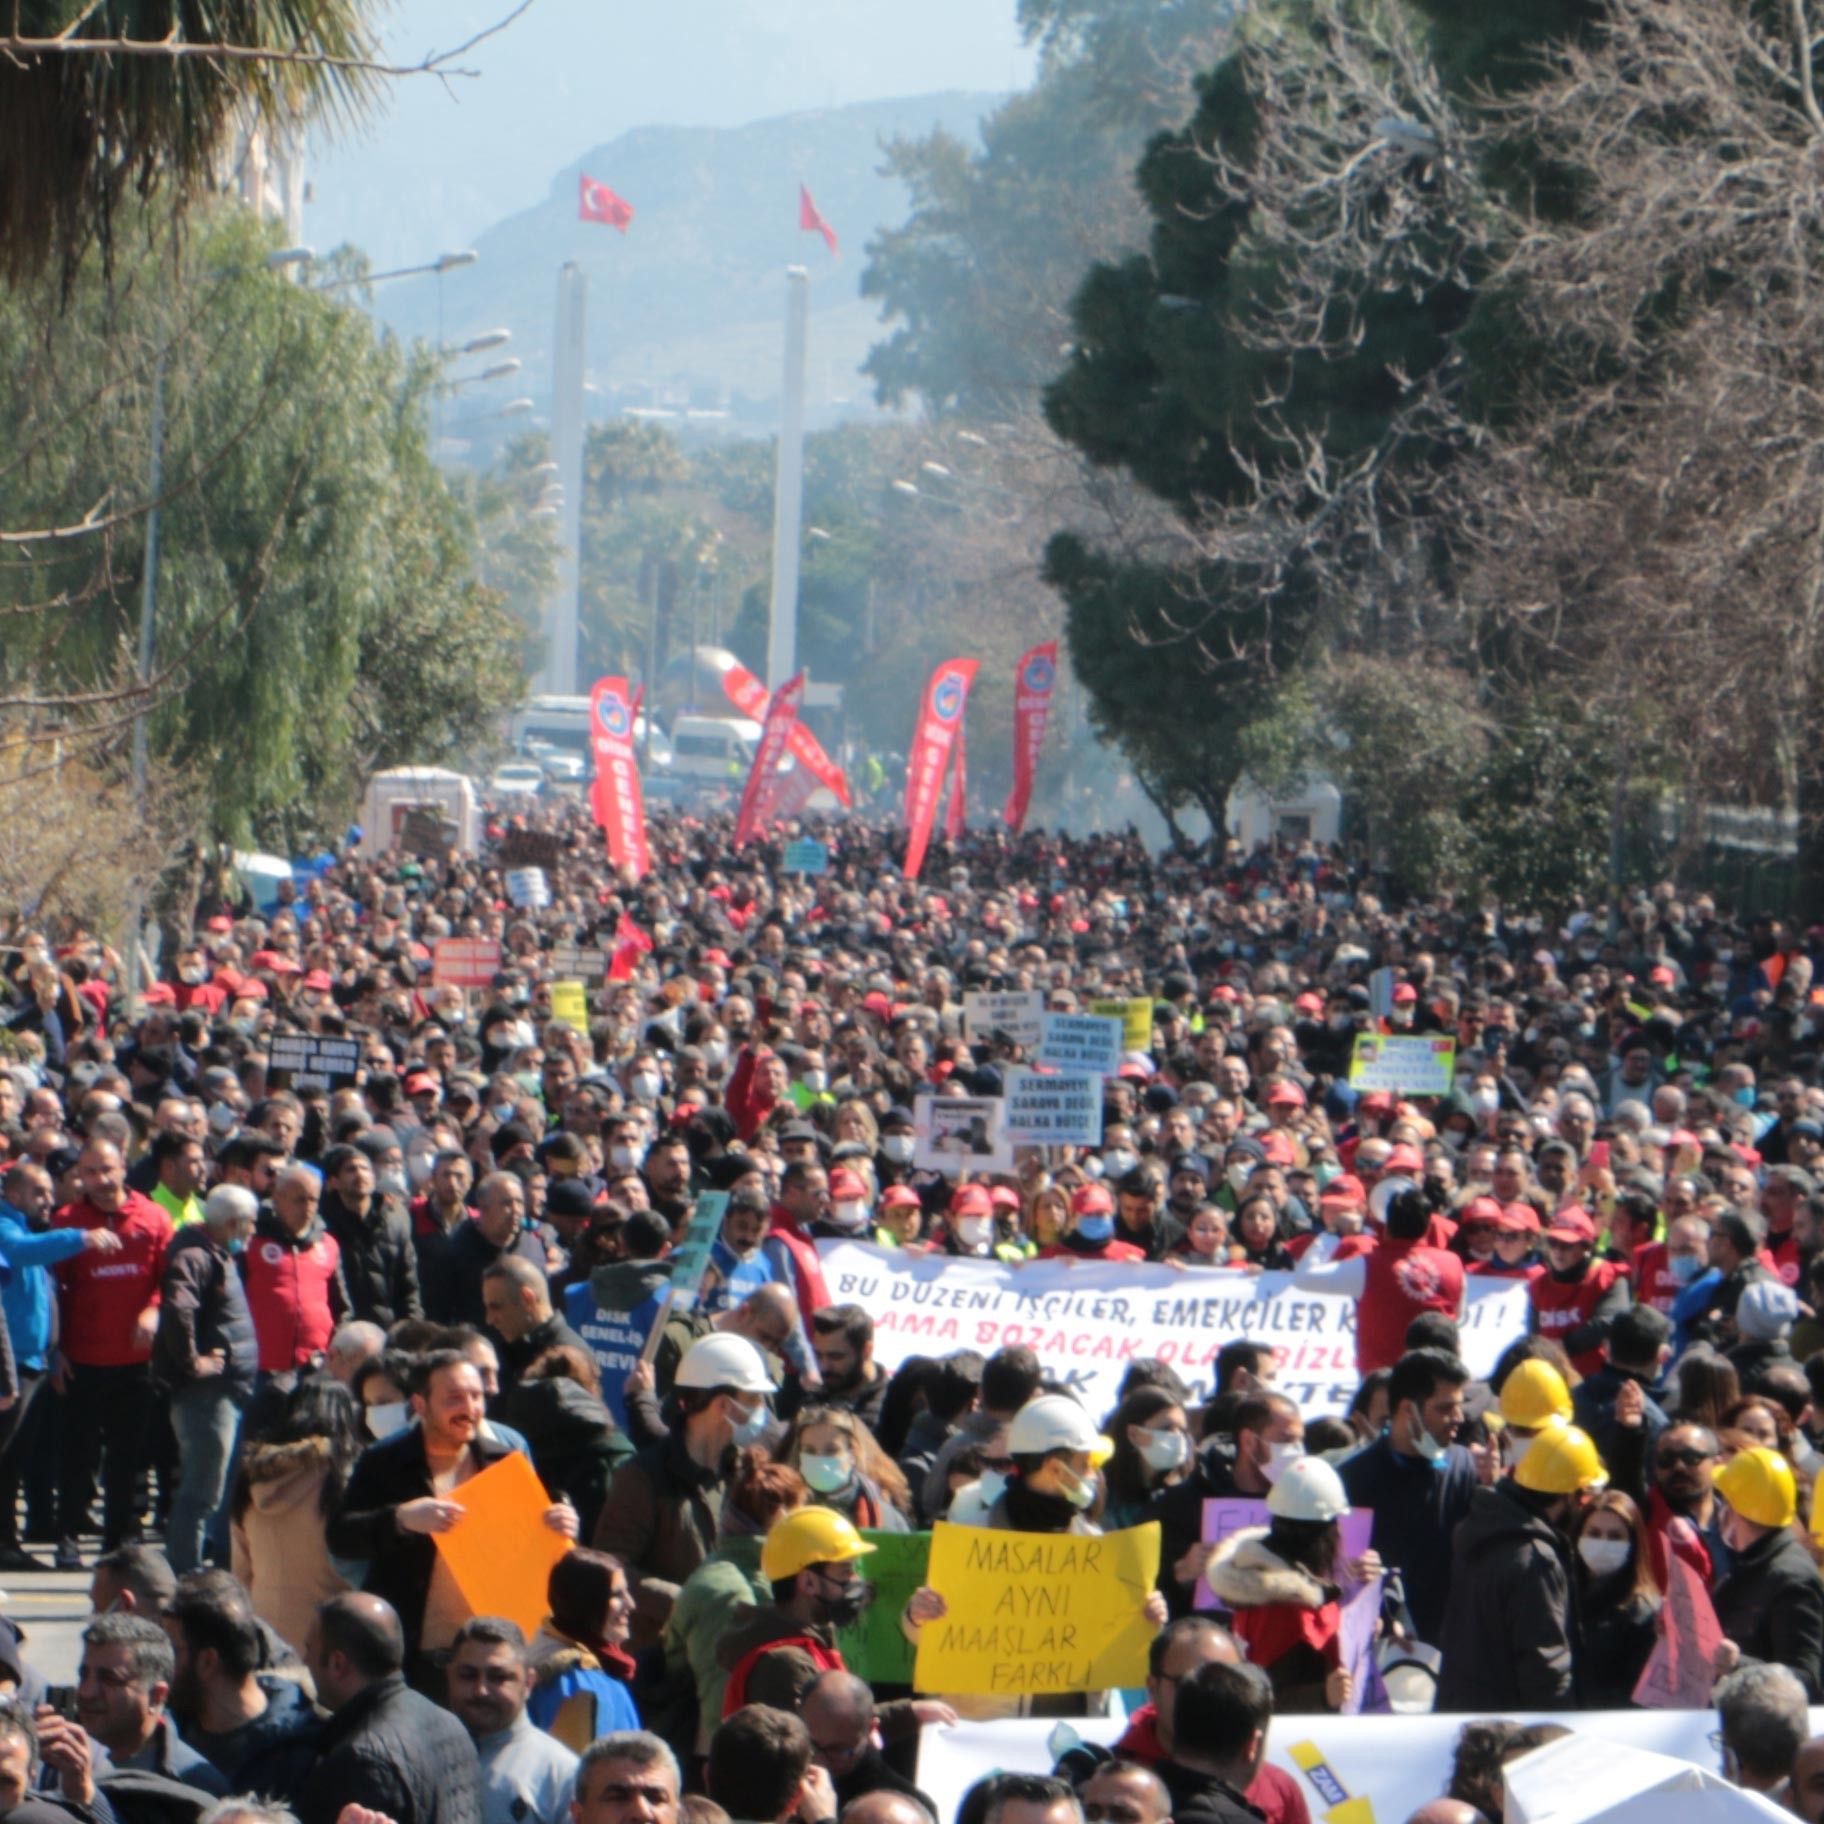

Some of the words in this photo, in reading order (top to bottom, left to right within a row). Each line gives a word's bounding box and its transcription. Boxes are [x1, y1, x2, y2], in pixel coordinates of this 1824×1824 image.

[90, 1263, 140, 1279] LACOSTE
[839, 1272, 879, 1297] BU
[975, 1320, 1144, 1362] BOZACAK
[965, 1537, 1103, 1578] MASALAR
[993, 1584, 1074, 1618] AYNI
[938, 1623, 1078, 1657] MAAŞLAR
[989, 1659, 1094, 1691] FARKLI
[1307, 1764, 1349, 1806] ZAM
